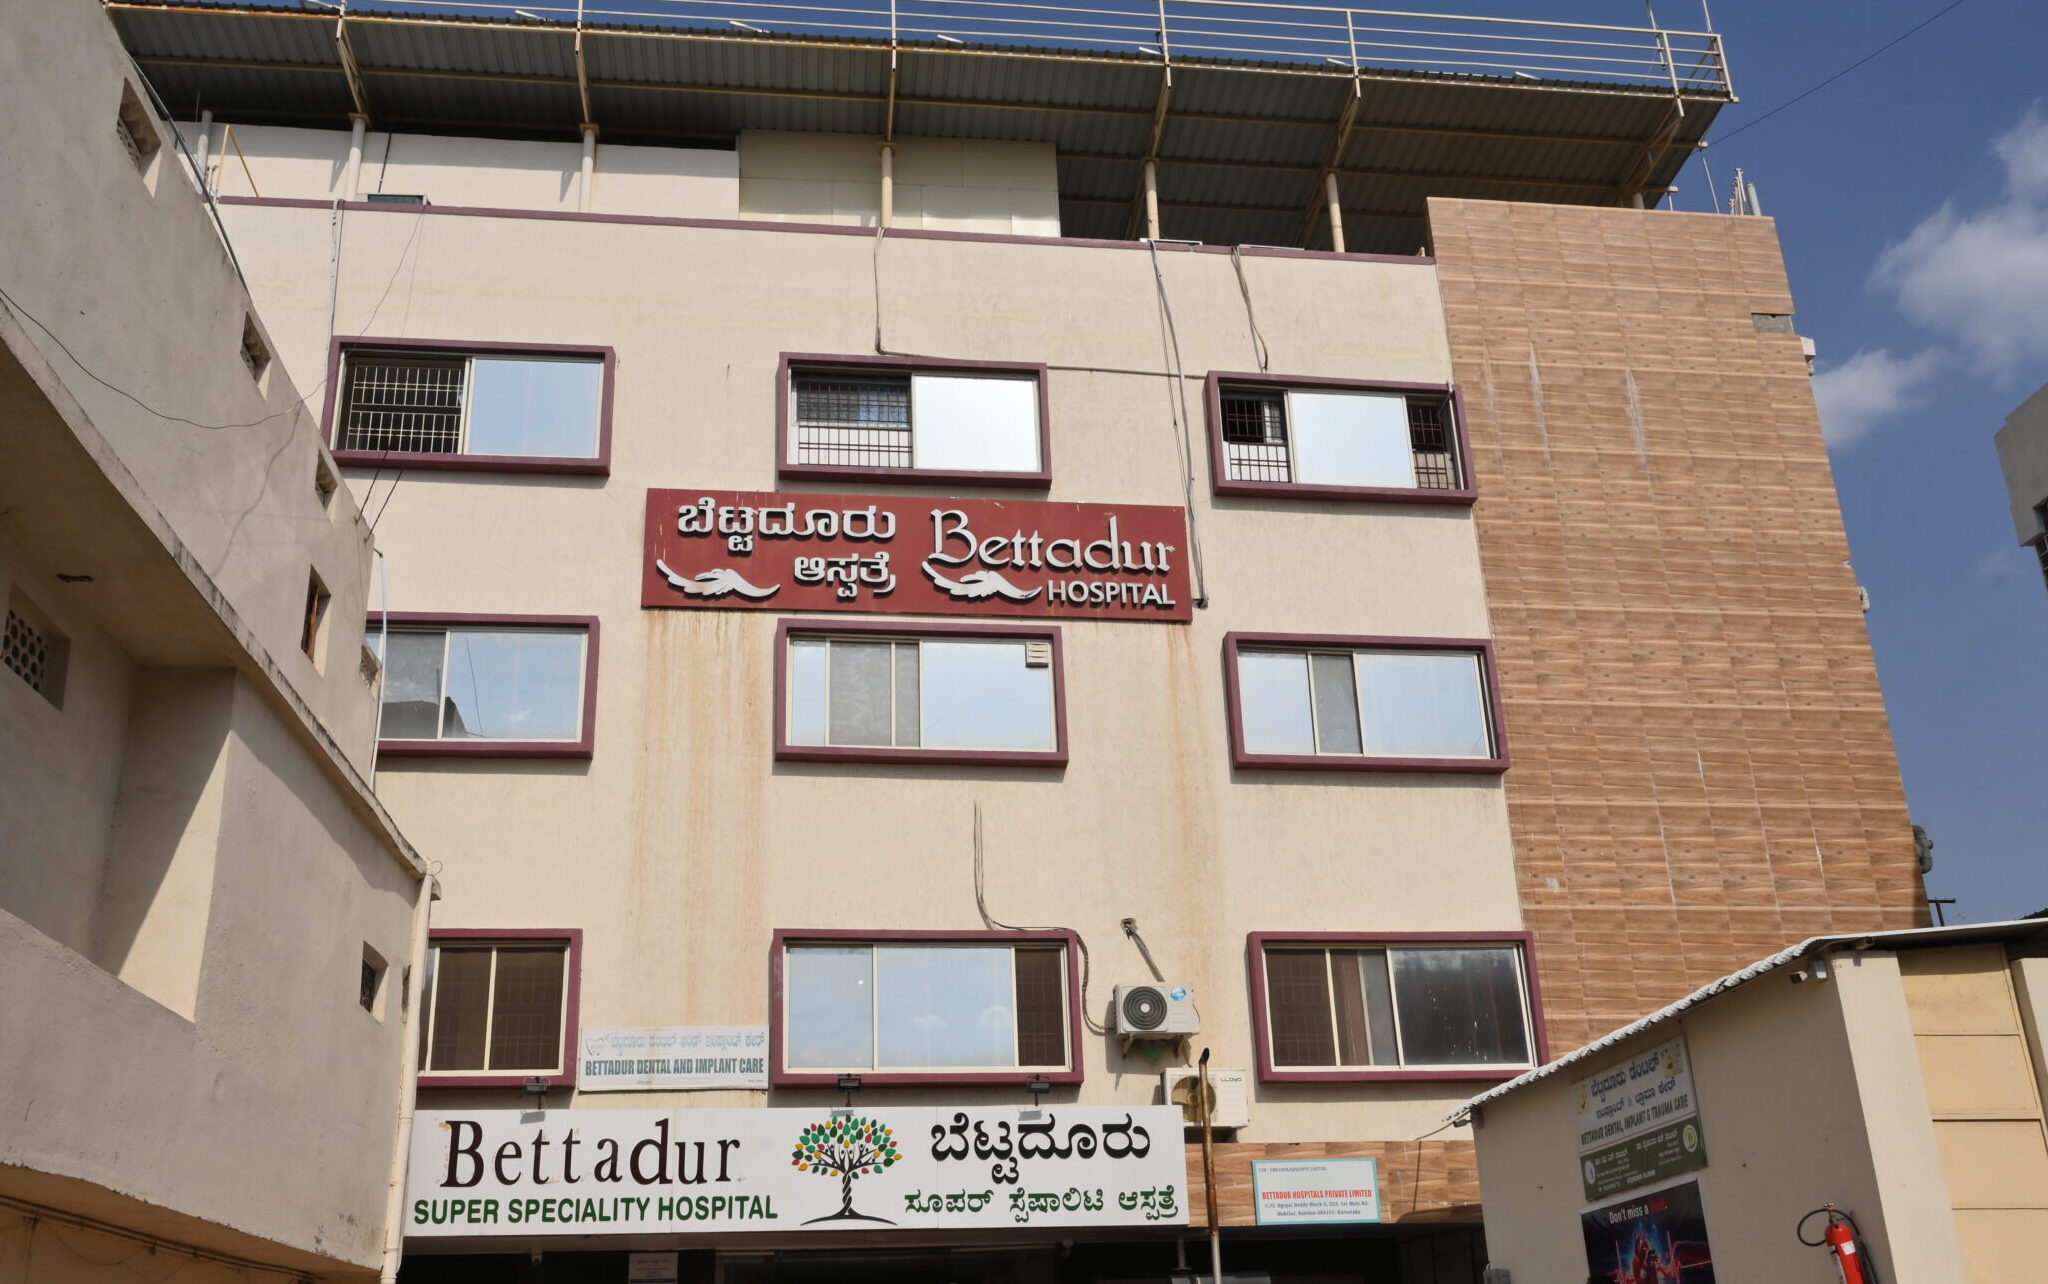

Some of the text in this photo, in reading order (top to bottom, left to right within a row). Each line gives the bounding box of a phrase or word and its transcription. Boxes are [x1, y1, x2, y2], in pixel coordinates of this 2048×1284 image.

[677, 497, 896, 553] ಬೆಟ್ಟದೂರು
[928, 509, 1176, 573] Bettadur
[794, 551, 896, 598] ಆಸ್ಪತ್ರೆ
[1048, 579, 1177, 606] HOSPITAL
[585, 1058, 764, 1076] BETTADUR DENTAL AND IMPLANT CARE
[1674, 1093, 1688, 1111] CARE
[440, 1117, 741, 1188] Bettadur
[931, 1112, 1150, 1185] ಬೆಟ್ಟದೂರು
[414, 1195, 778, 1225] SUPER SPECIALITY HOSPITAL
[904, 1189, 994, 1213] ಸೂಪರ್
[1118, 1184, 1179, 1221] ಆಸ್ಪತ್ರೆ
[1262, 1189, 1372, 1200] BETTADUR HOSPITALS PRIVATE LIMITED
[1609, 1207, 1627, 1224] Don't
[1627, 1203, 1643, 1220] miss
[1644, 1204, 1650, 1215] a
